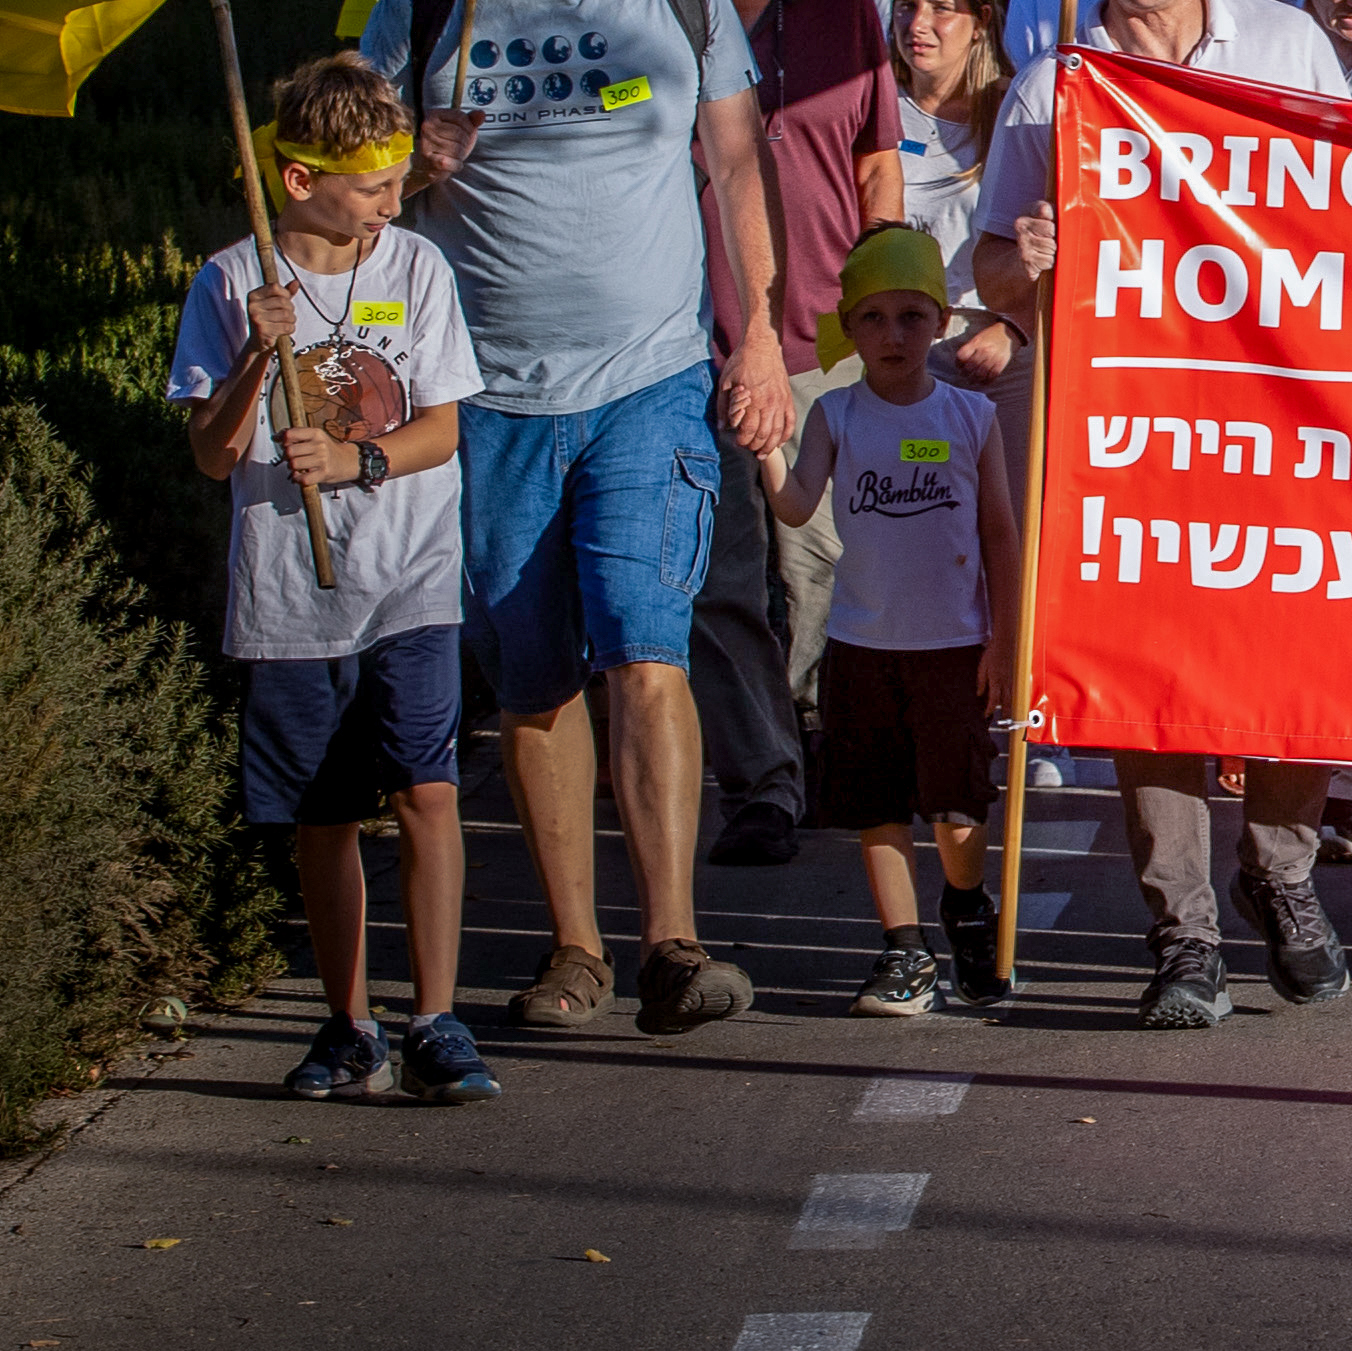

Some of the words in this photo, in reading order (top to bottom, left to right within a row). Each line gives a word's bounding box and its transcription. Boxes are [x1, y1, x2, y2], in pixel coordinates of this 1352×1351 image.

[607, 85, 641, 105] 300
[484, 112, 527, 124] OON
[361, 307, 399, 322] 300
[906, 443, 940, 459] 300
[1088, 415, 1273, 476] הירש
